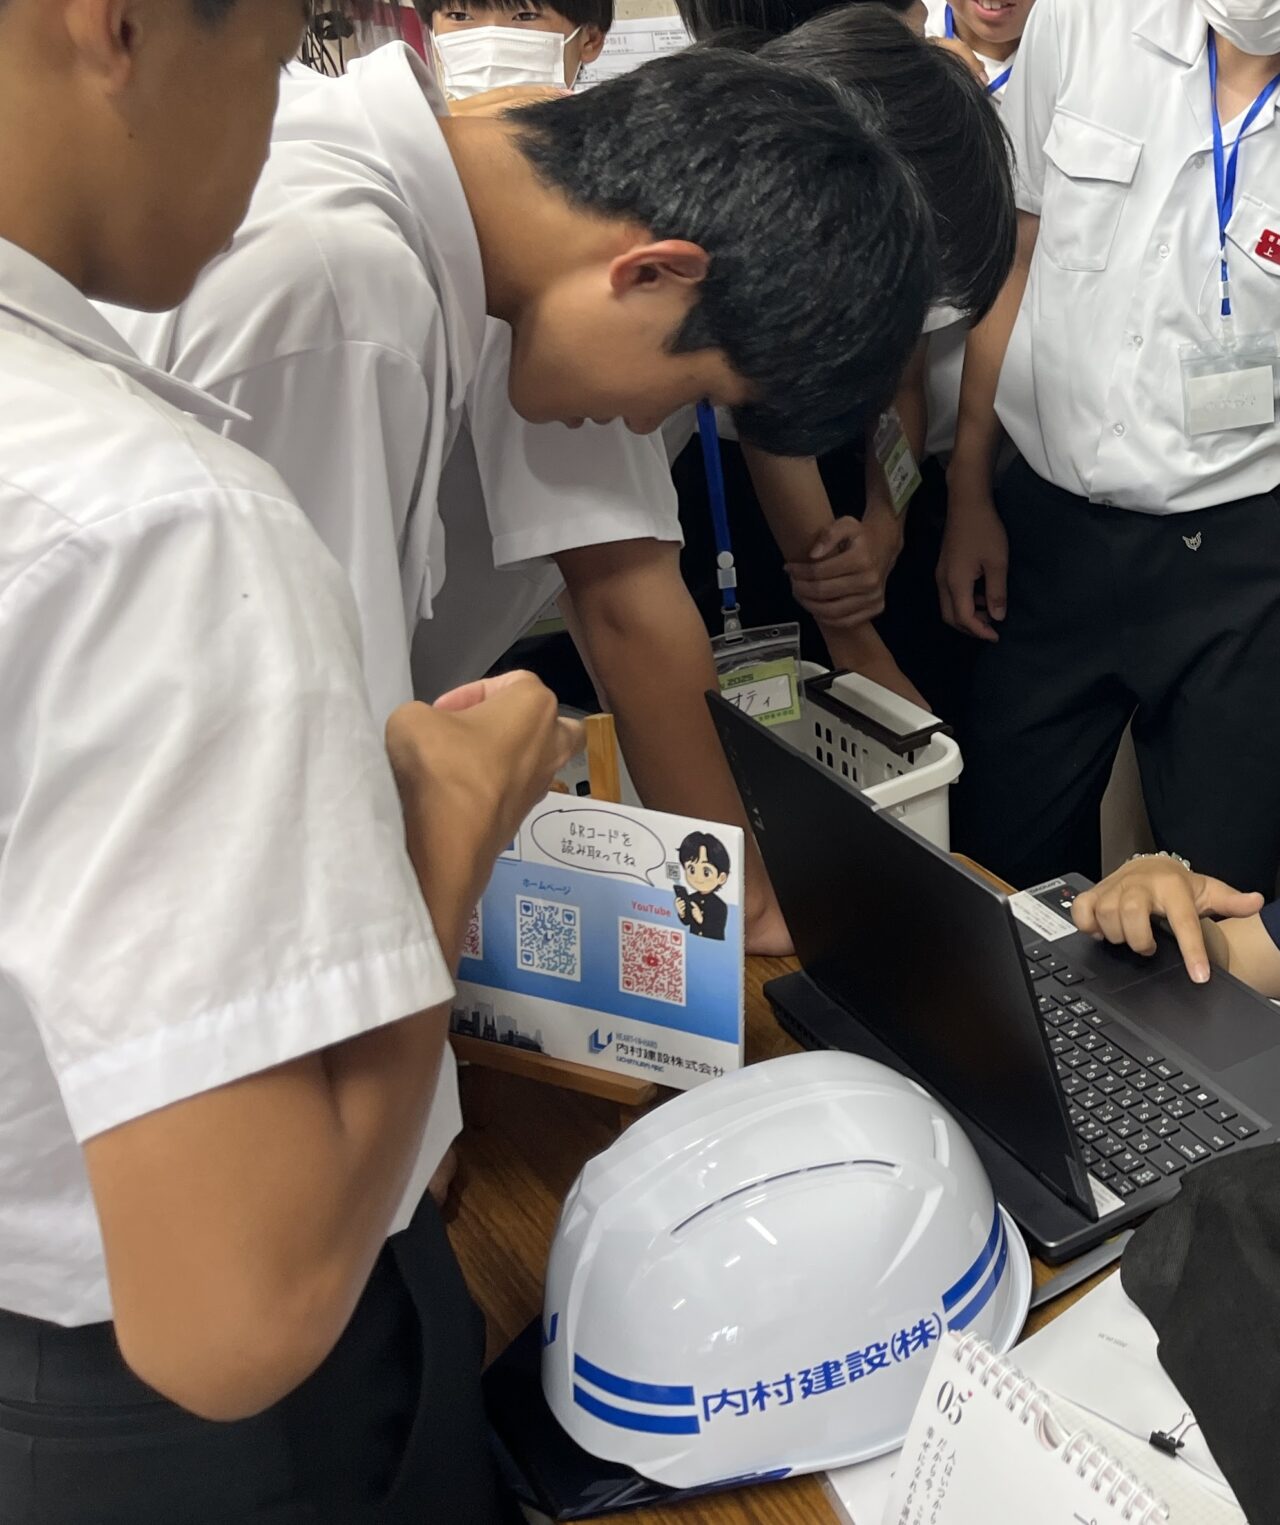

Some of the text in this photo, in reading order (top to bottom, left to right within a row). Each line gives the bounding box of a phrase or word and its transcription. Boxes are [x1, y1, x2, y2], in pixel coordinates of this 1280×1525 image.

[570, 822, 632, 847] QRコードを
[561, 838, 636, 867] 読み取ってね
[523, 878, 571, 895] ホームページ
[632, 901, 672, 917] YouTube
[616, 1043, 725, 1078] 内村建設株式会社
[703, 1312, 942, 1422] 内村建設(株)
[937, 1380, 967, 1426] 05
